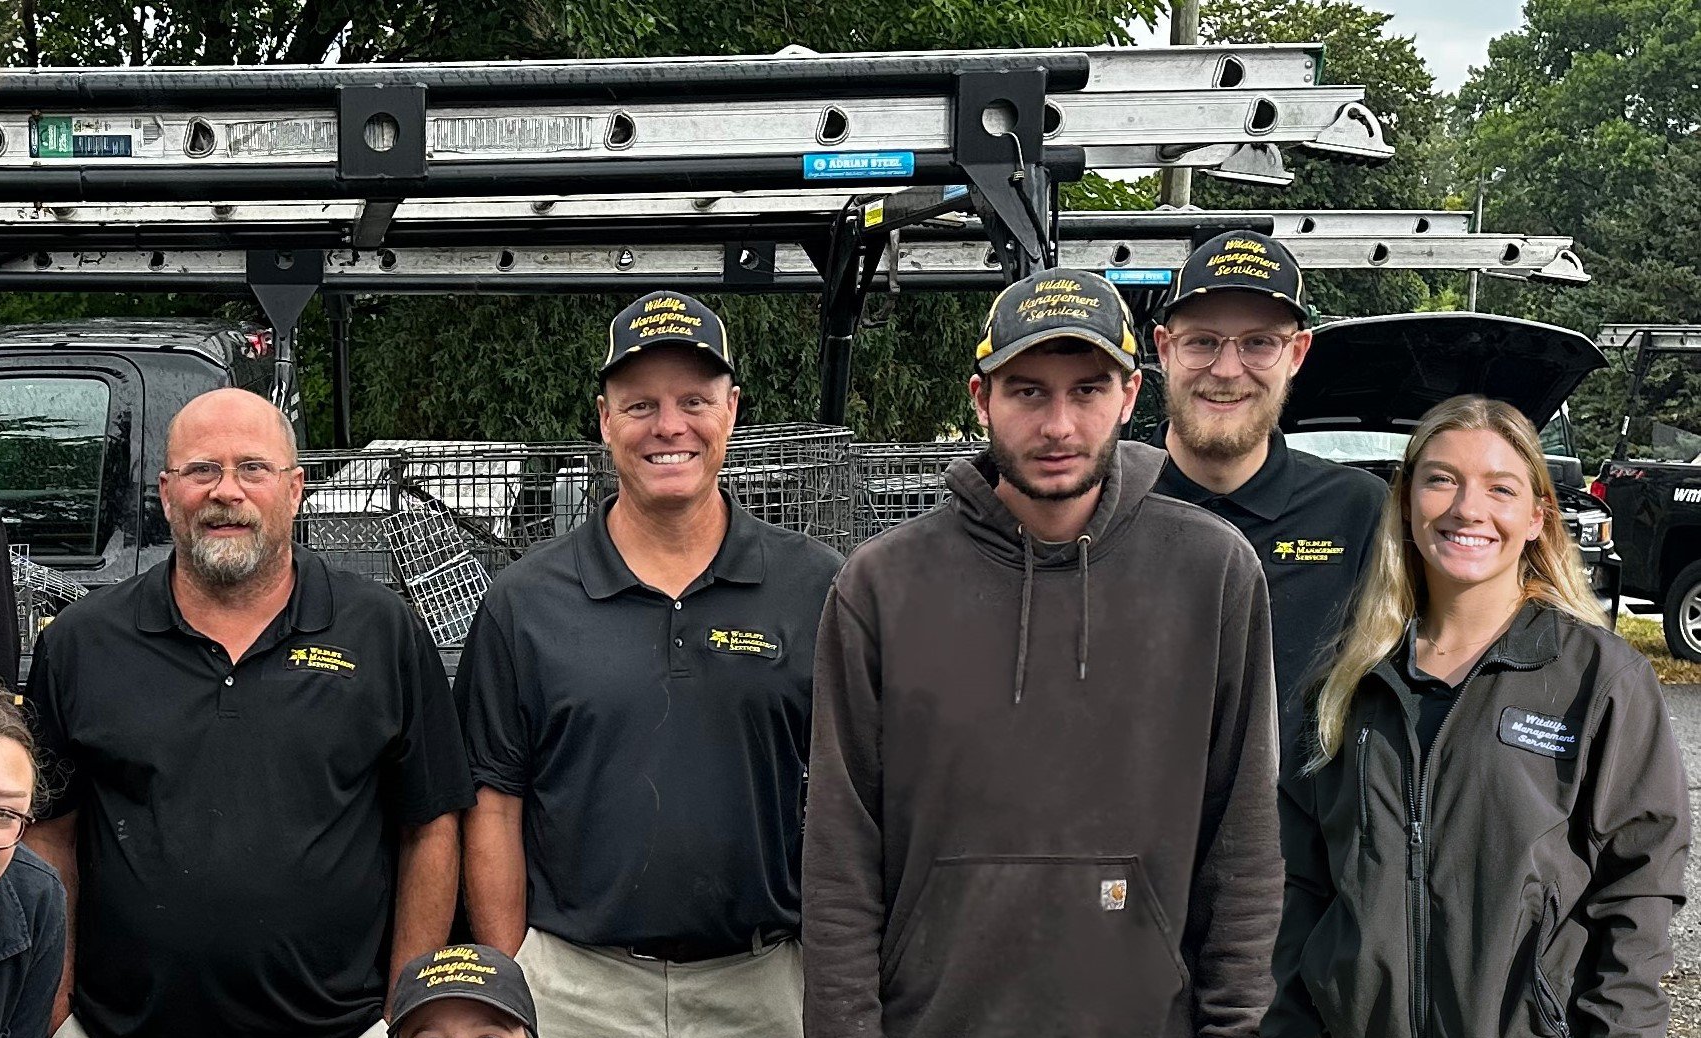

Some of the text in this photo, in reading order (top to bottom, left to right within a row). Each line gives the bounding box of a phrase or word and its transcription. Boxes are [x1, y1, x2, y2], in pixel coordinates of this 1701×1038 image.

[828, 157, 902, 169] ADRIAN STEEL
[1224, 240, 1267, 254] Wildlife
[1206, 252, 1281, 271] Management
[1214, 264, 1271, 279] Services
[1035, 279, 1082, 293] Wildlife
[644, 298, 687, 312] Wildlife
[1016, 293, 1100, 313] Management
[629, 312, 702, 330] Management
[1026, 306, 1089, 322] Services
[639, 323, 694, 338] Services
[1525, 714, 1568, 733] Wildlife
[1511, 721, 1576, 743] Management
[1518, 734, 1566, 753] Services
[434, 947, 480, 962] Wildlife
[415, 961, 498, 980] Management
[426, 972, 486, 988] Services
